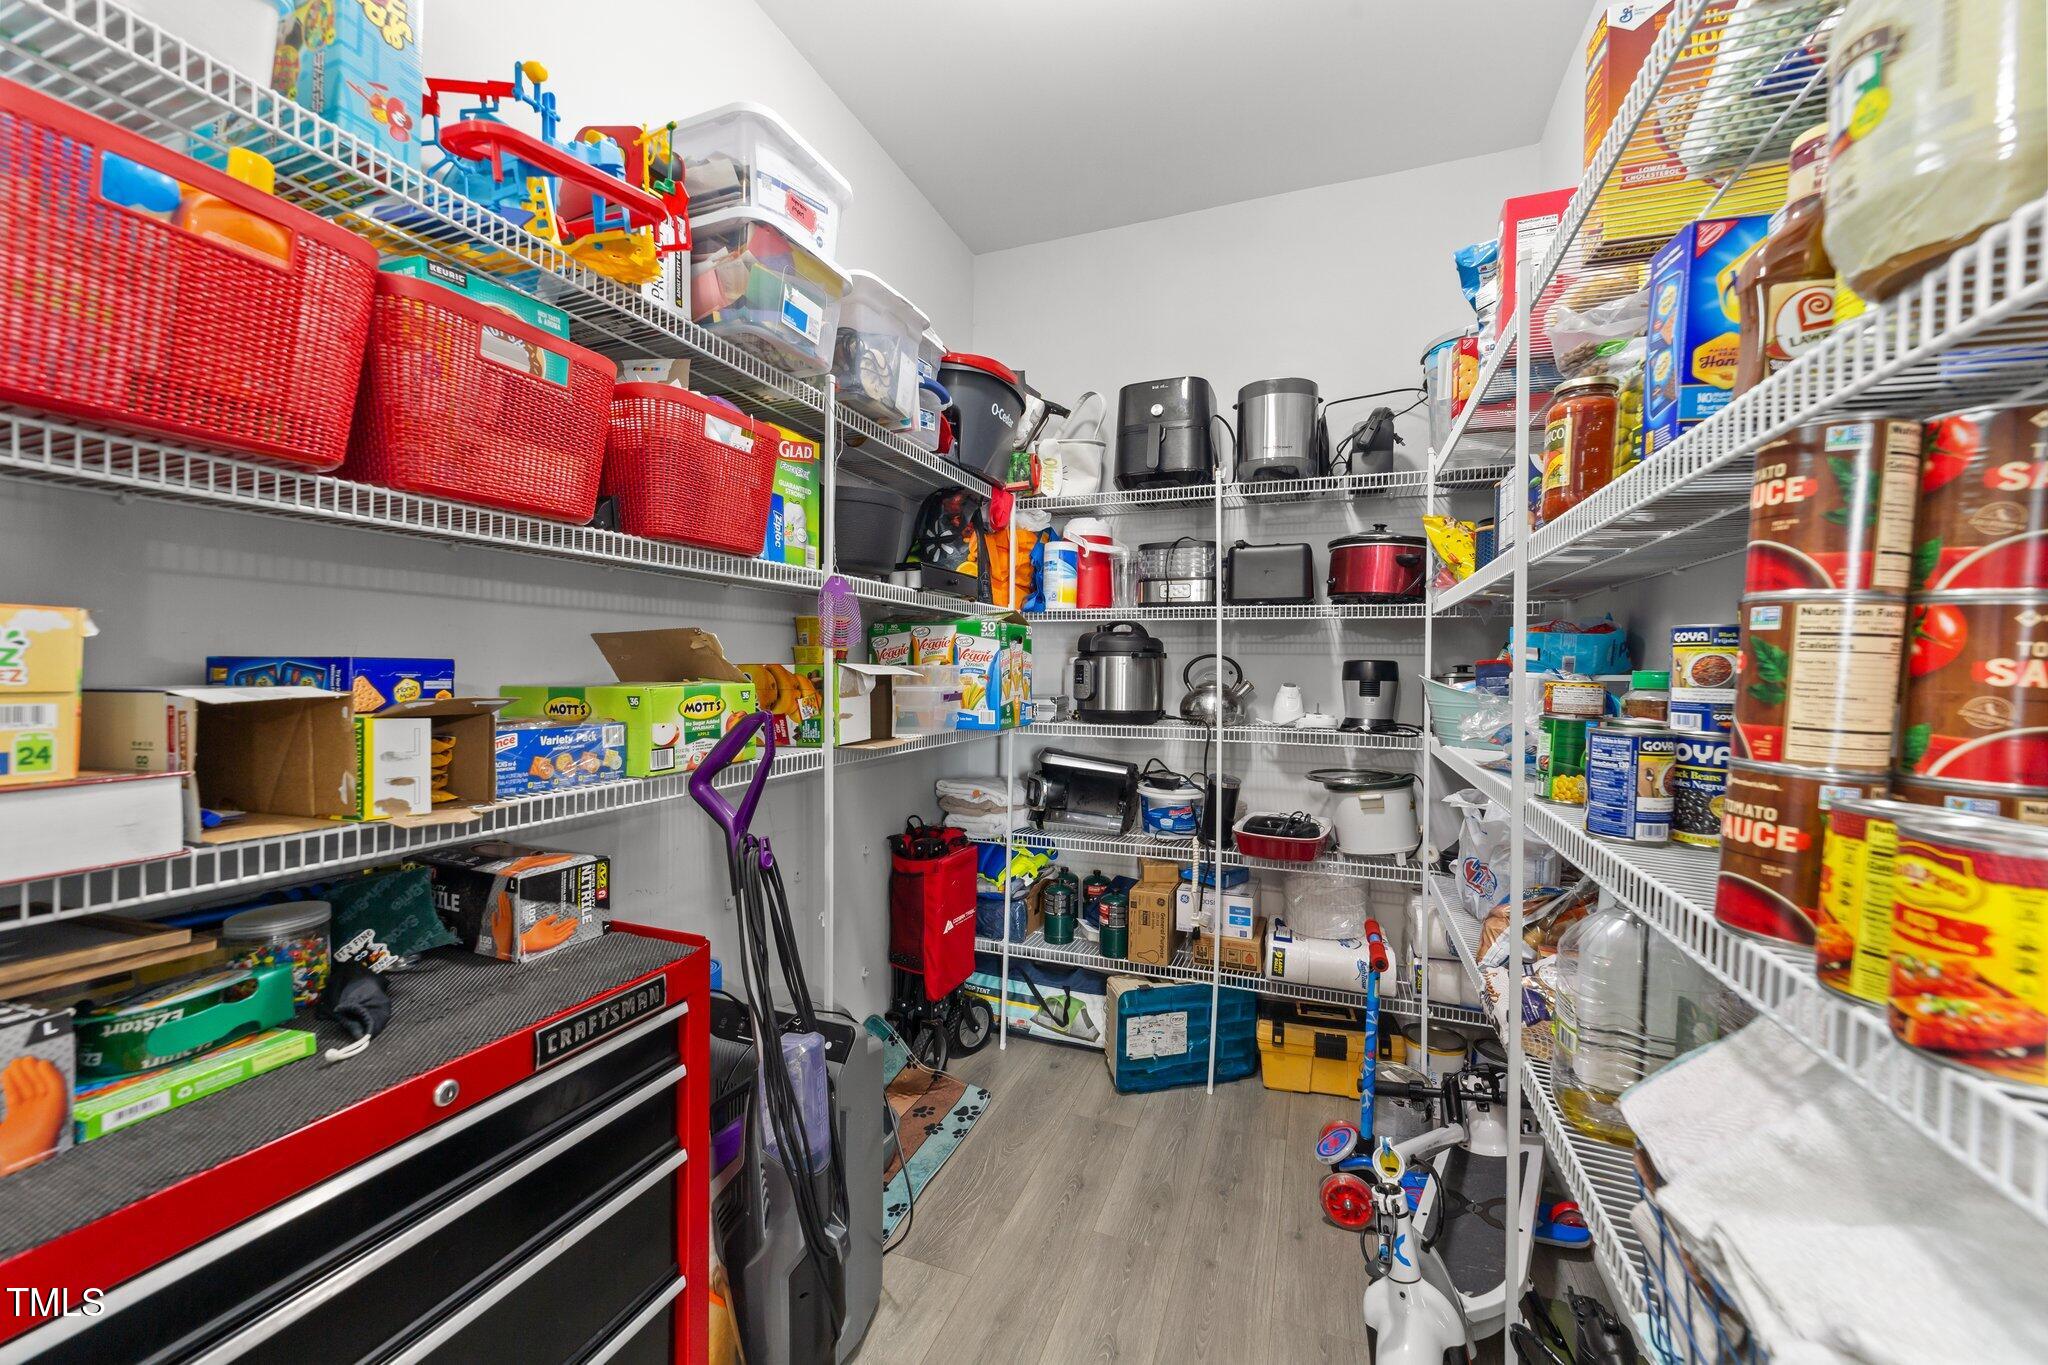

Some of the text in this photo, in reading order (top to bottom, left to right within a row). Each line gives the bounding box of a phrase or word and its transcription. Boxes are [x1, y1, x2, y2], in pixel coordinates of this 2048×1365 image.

[428, 262, 466, 283] KEURIG
[1699, 355, 1738, 370] Hon
[991, 403, 1014, 428] O-Cedar
[779, 440, 813, 459] GLAD
[1751, 475, 1807, 510] UCE
[773, 511, 783, 548] Ziploc
[981, 621, 996, 632] 30
[918, 636, 950, 651] Veggie
[1674, 631, 1709, 643] GOYA
[877, 643, 909, 662] Veggie
[959, 648, 994, 662] Veggie
[629, 697, 639, 706] 36
[684, 701, 721, 713] MOTT'S
[549, 704, 586, 715] MOTT'S
[495, 736, 517, 748] nce
[540, 731, 597, 746] Variety Pack
[17, 746, 51, 766] 24
[1676, 742, 1730, 765] OYA
[1690, 771, 1722, 782] Beans
[1721, 813, 1800, 853] AUCE
[581, 864, 593, 924] NITRILE
[1274, 950, 1283, 958] 9
[976, 986, 991, 994] TENT
[547, 985, 661, 1054] CRAFTSMAN
[43, 1021, 60, 1036] L
